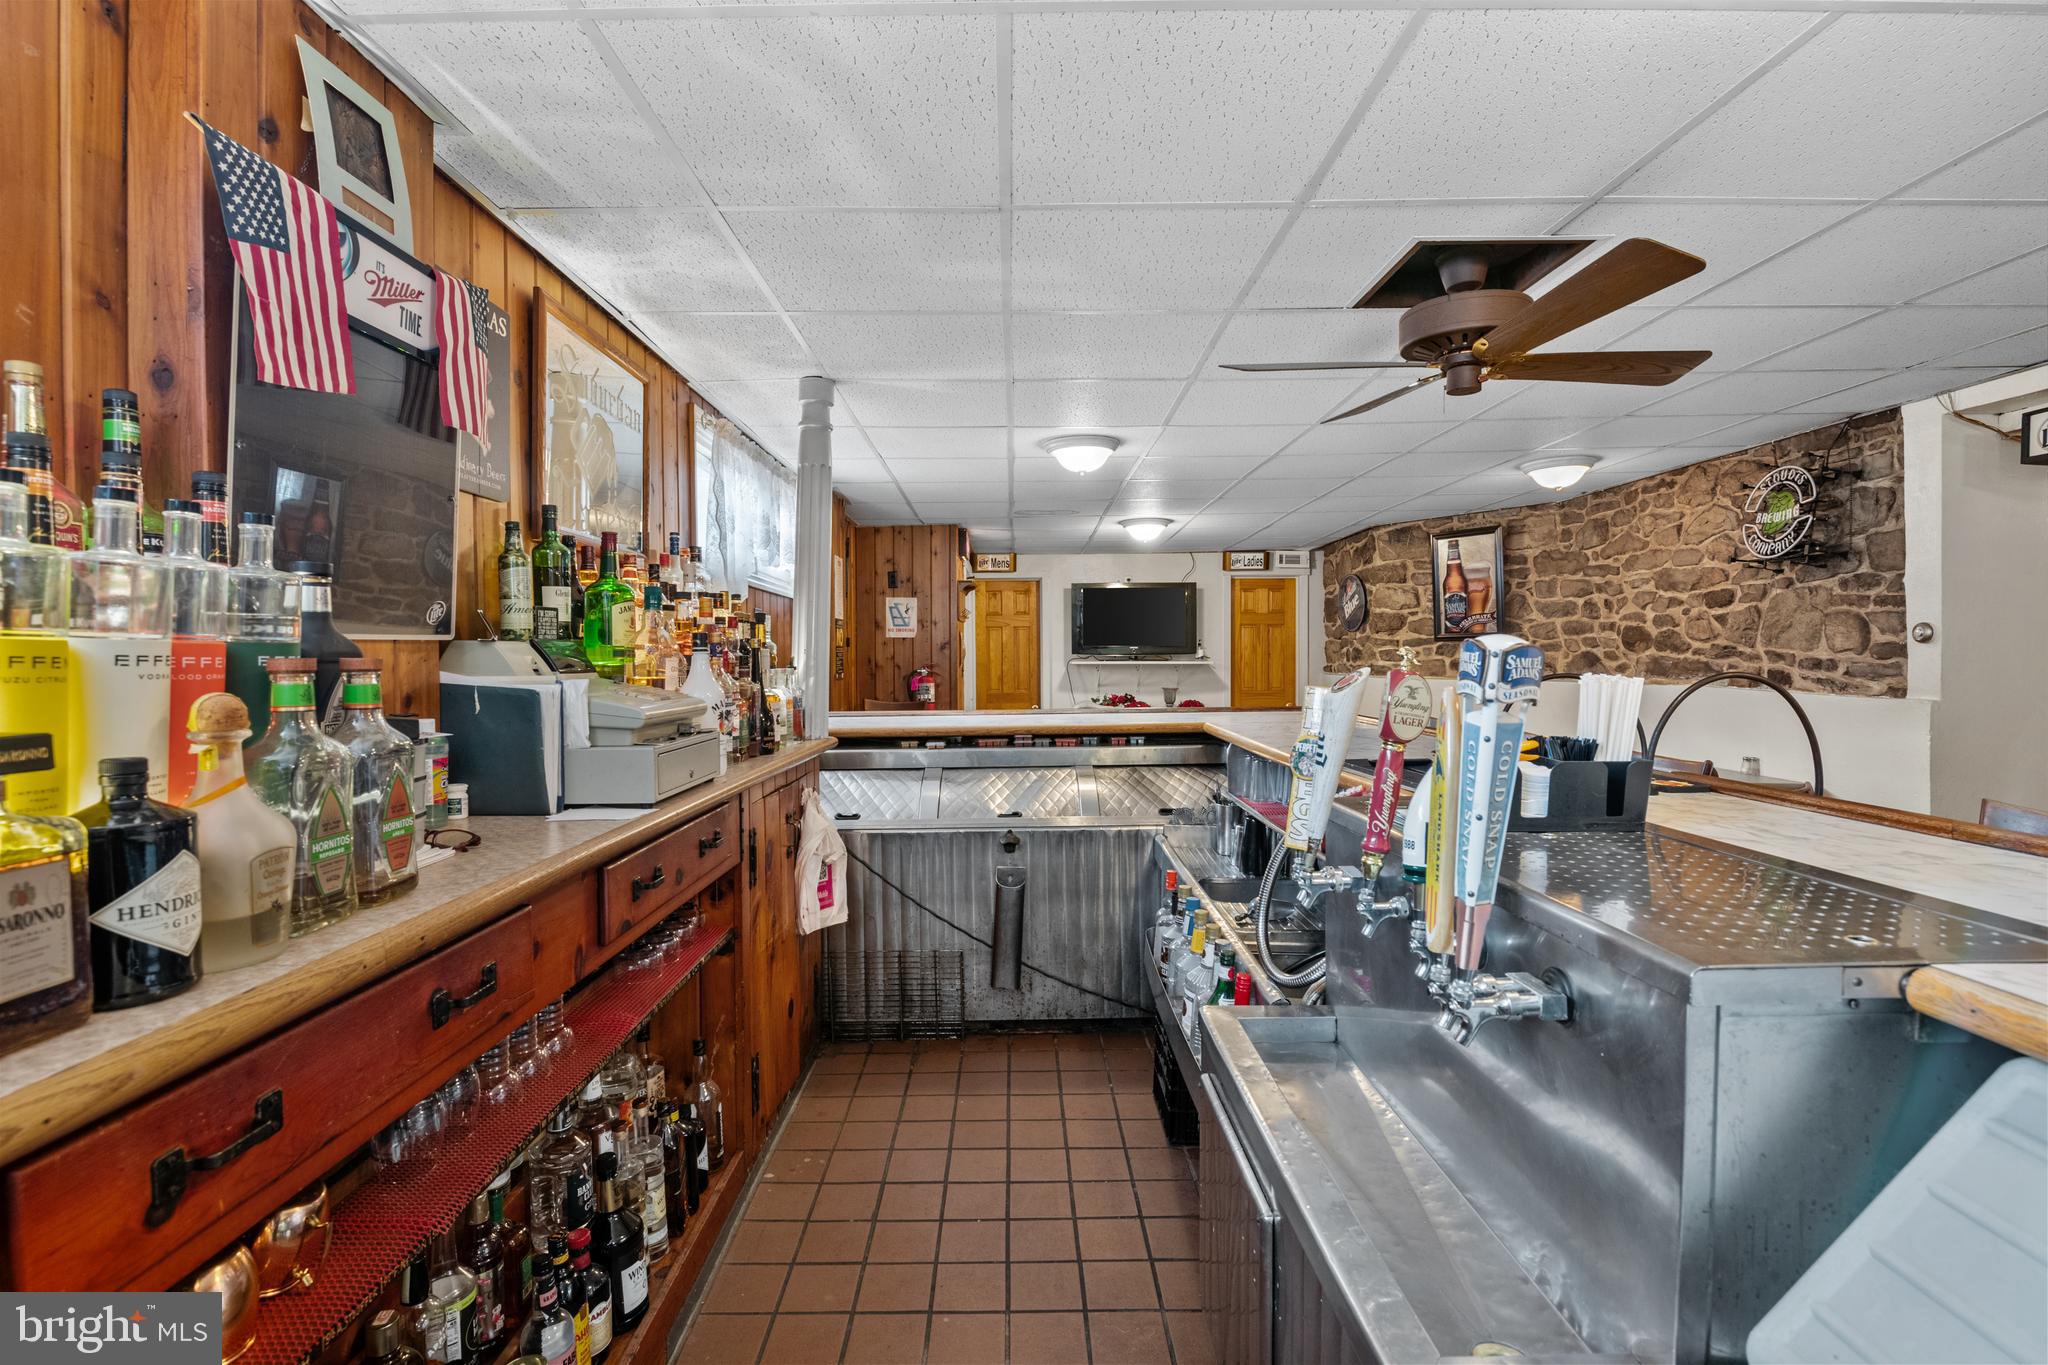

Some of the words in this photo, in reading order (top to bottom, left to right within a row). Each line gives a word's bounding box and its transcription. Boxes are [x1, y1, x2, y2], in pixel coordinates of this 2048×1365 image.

[375, 260, 386, 275] IT'S
[364, 269, 425, 301] Miller
[400, 305, 422, 337] TIME
[487, 306, 507, 337] AS
[1756, 504, 1800, 523] BREWING
[1748, 531, 1795, 555] COMPANY
[990, 557, 1010, 569] Mens
[1243, 555, 1263, 567] Ladies
[1343, 594, 1360, 619] Blue
[1446, 600, 1466, 609] SAMUEL
[1446, 606, 1466, 614] ADAMS
[1506, 654, 1542, 670] SAMUEL
[1508, 667, 1541, 681] ADAMS
[1391, 695, 1430, 713] Yuengling
[1393, 717, 1424, 728] LAGER
[1294, 741, 1318, 753] PERPET
[1494, 740, 1513, 802] COLD
[1371, 767, 1398, 839] Yuengling
[383, 816, 414, 833] HORNITOS
[312, 834, 351, 853] HORNITOS
[1485, 810, 1503, 870] SNAP
